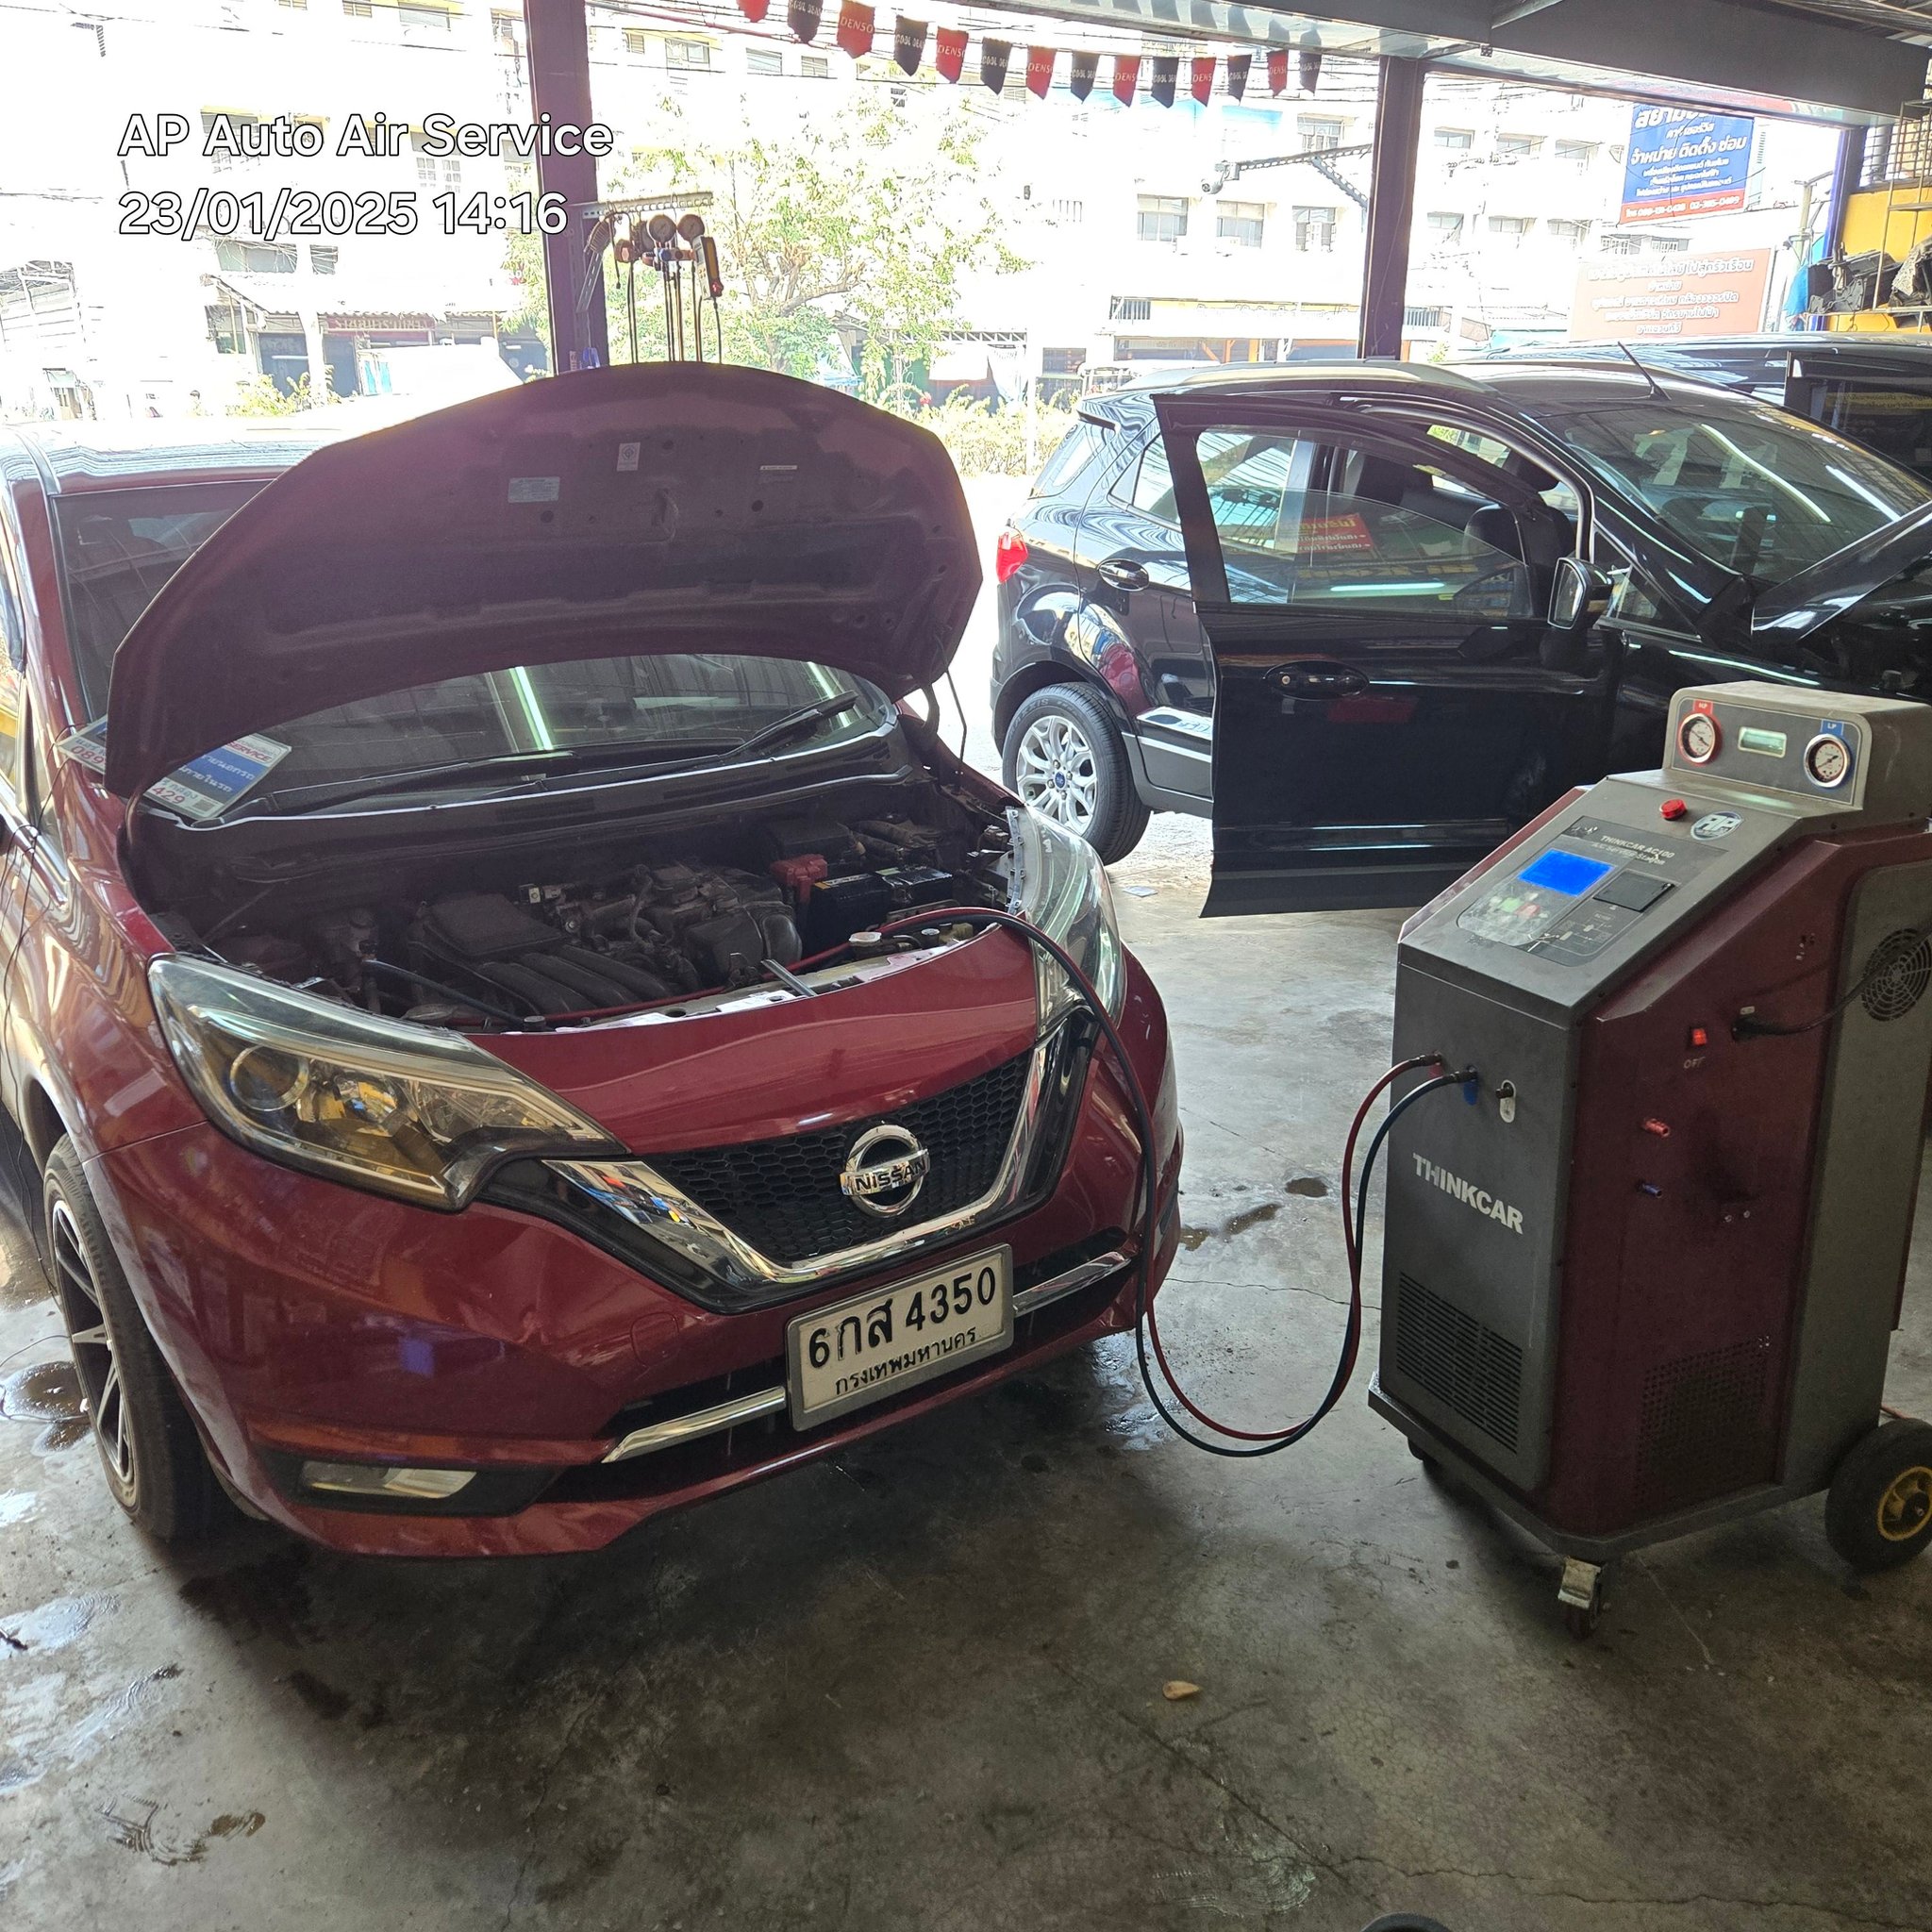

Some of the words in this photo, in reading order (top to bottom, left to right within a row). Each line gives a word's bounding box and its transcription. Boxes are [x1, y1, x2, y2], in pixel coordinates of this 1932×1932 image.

[840, 16, 874, 33] DENSO
[1630, 146, 1676, 165] จำหน่าย
[1679, 136, 1717, 158] ติดตั้ง
[1718, 134, 1747, 153] ซ่อม
[1679, 291, 1739, 304] กล้องวงจรปิด
[226, 741, 272, 762] SERVICE
[152, 786, 186, 805] 429
[1600, 835, 1645, 851] THINKCAR
[1643, 846, 1675, 858] AC100
[855, 1160, 925, 1191] NISSAN
[1413, 1152, 1523, 1235] THINKCAR
[808, 1298, 893, 1368] 6กส
[906, 1266, 996, 1331] 4350
